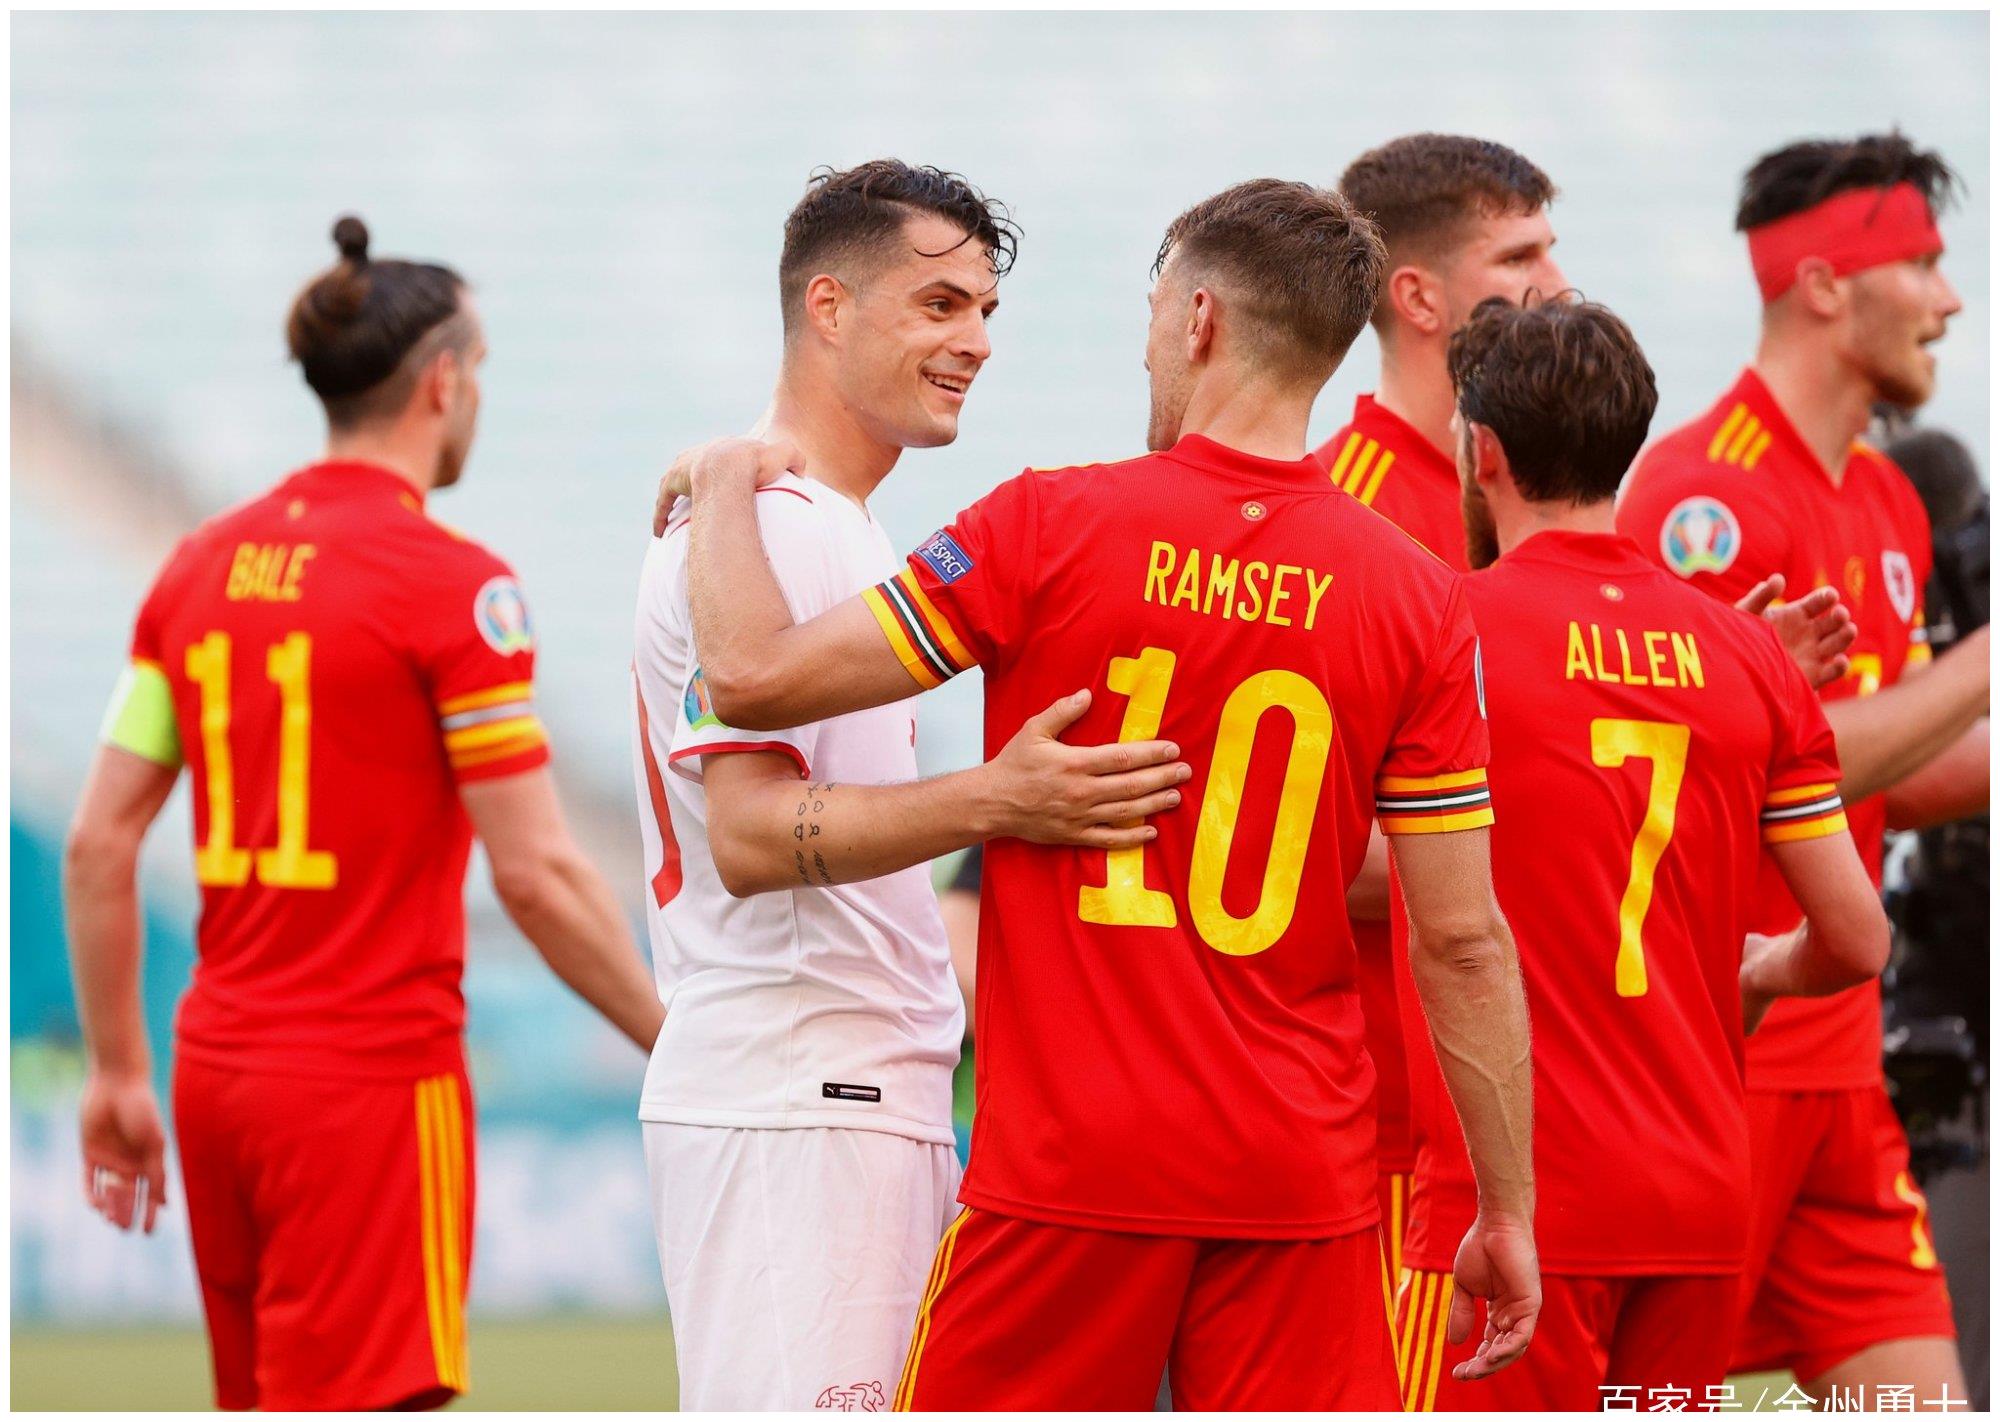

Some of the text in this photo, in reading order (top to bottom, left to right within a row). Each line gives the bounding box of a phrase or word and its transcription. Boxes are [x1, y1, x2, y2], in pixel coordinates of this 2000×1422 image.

[226, 542, 316, 601] BALE
[927, 539, 967, 578] ESPECT
[1144, 540, 1334, 631] RAMSEY
[1565, 621, 1705, 688] ALLEN
[185, 631, 337, 889] 11
[1077, 646, 1334, 957] 10
[1590, 717, 1691, 998] 7
